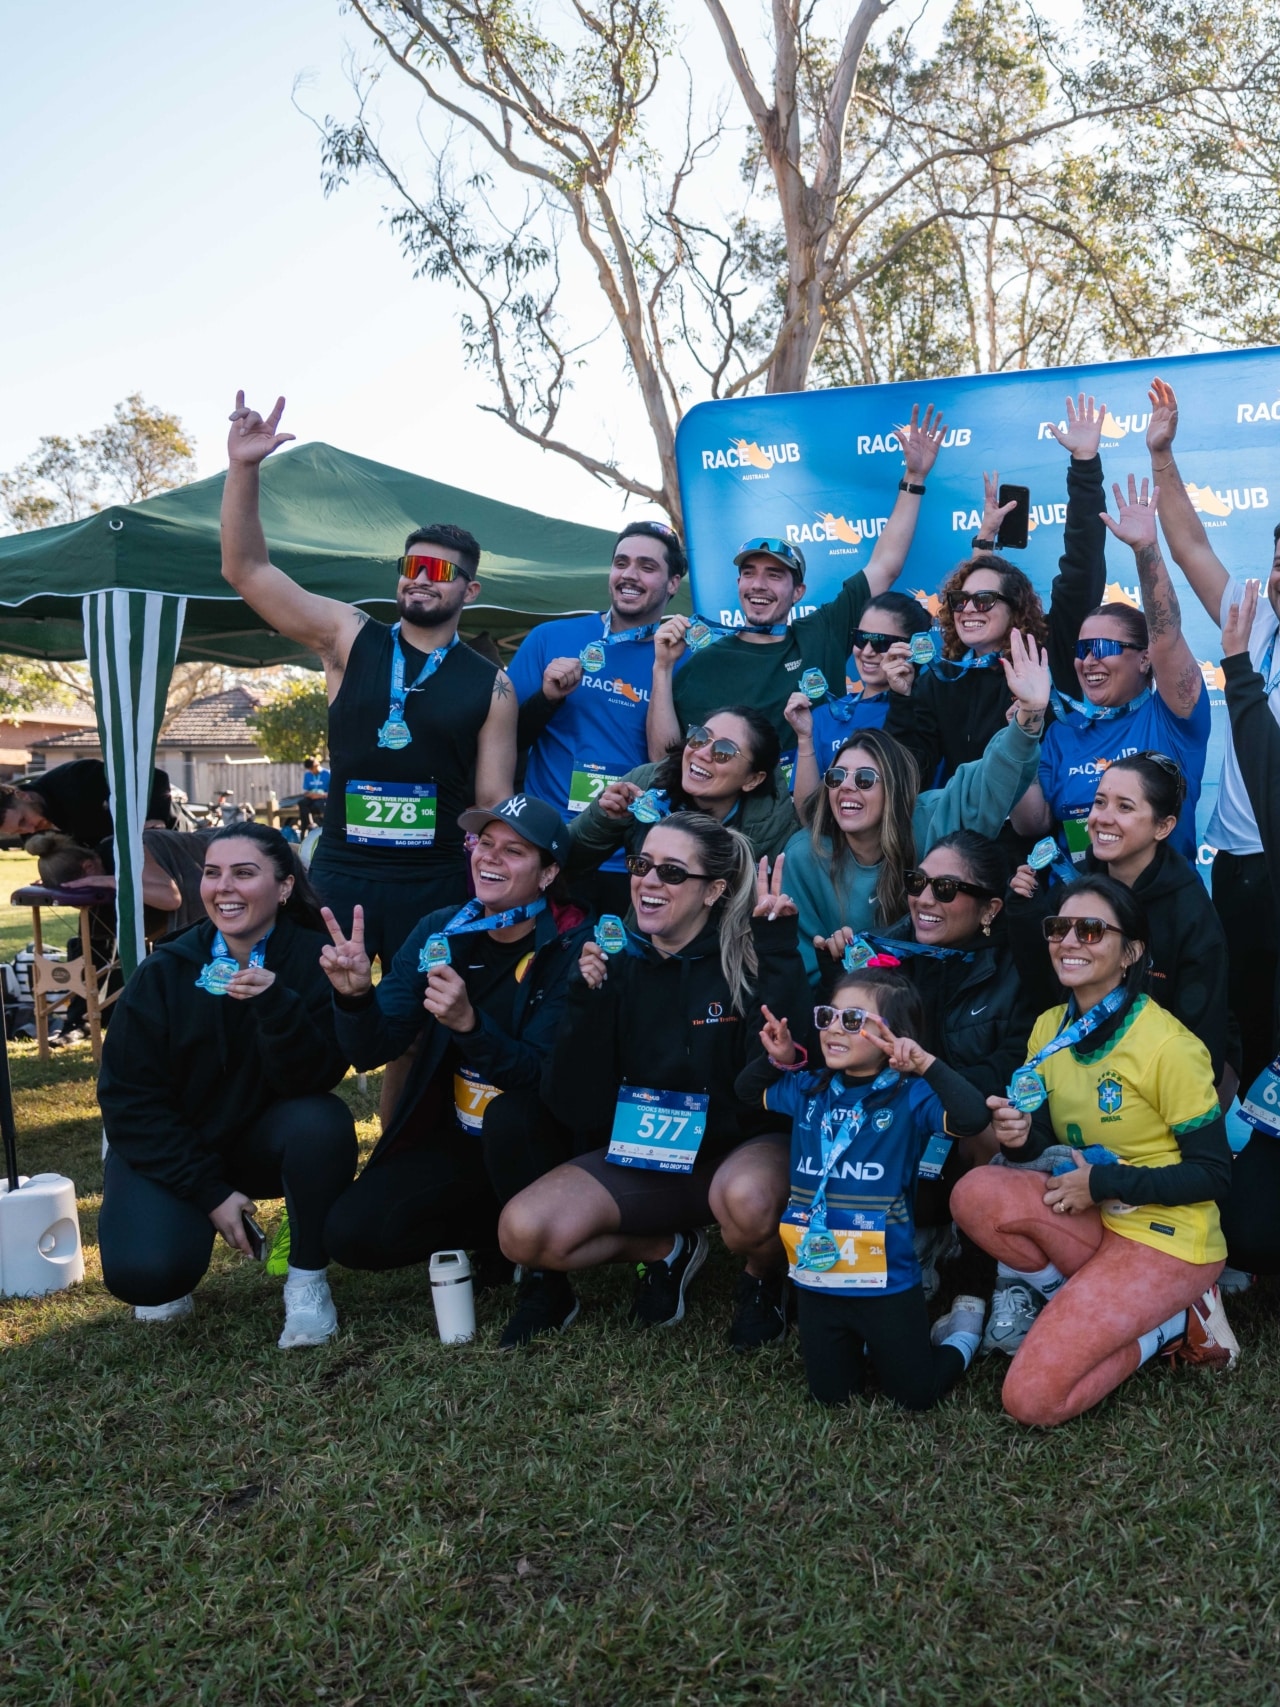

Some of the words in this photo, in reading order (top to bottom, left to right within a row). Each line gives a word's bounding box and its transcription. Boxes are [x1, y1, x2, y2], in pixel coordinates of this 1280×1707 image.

[857, 433, 904, 455] RAC
[702, 447, 751, 470] RACE
[763, 442, 800, 464] HUB
[742, 473, 770, 481] AUSTRALIA
[1218, 487, 1269, 511] HUB
[952, 510, 984, 531] RA
[786, 519, 838, 544] RACE
[829, 548, 858, 556] AUSTRALIA
[581, 675, 624, 695] RACE
[608, 697, 636, 708] AUSTRALIA
[365, 801, 417, 824] 278
[637, 1105, 657, 1113] COOKS
[637, 1113, 689, 1141] 577
